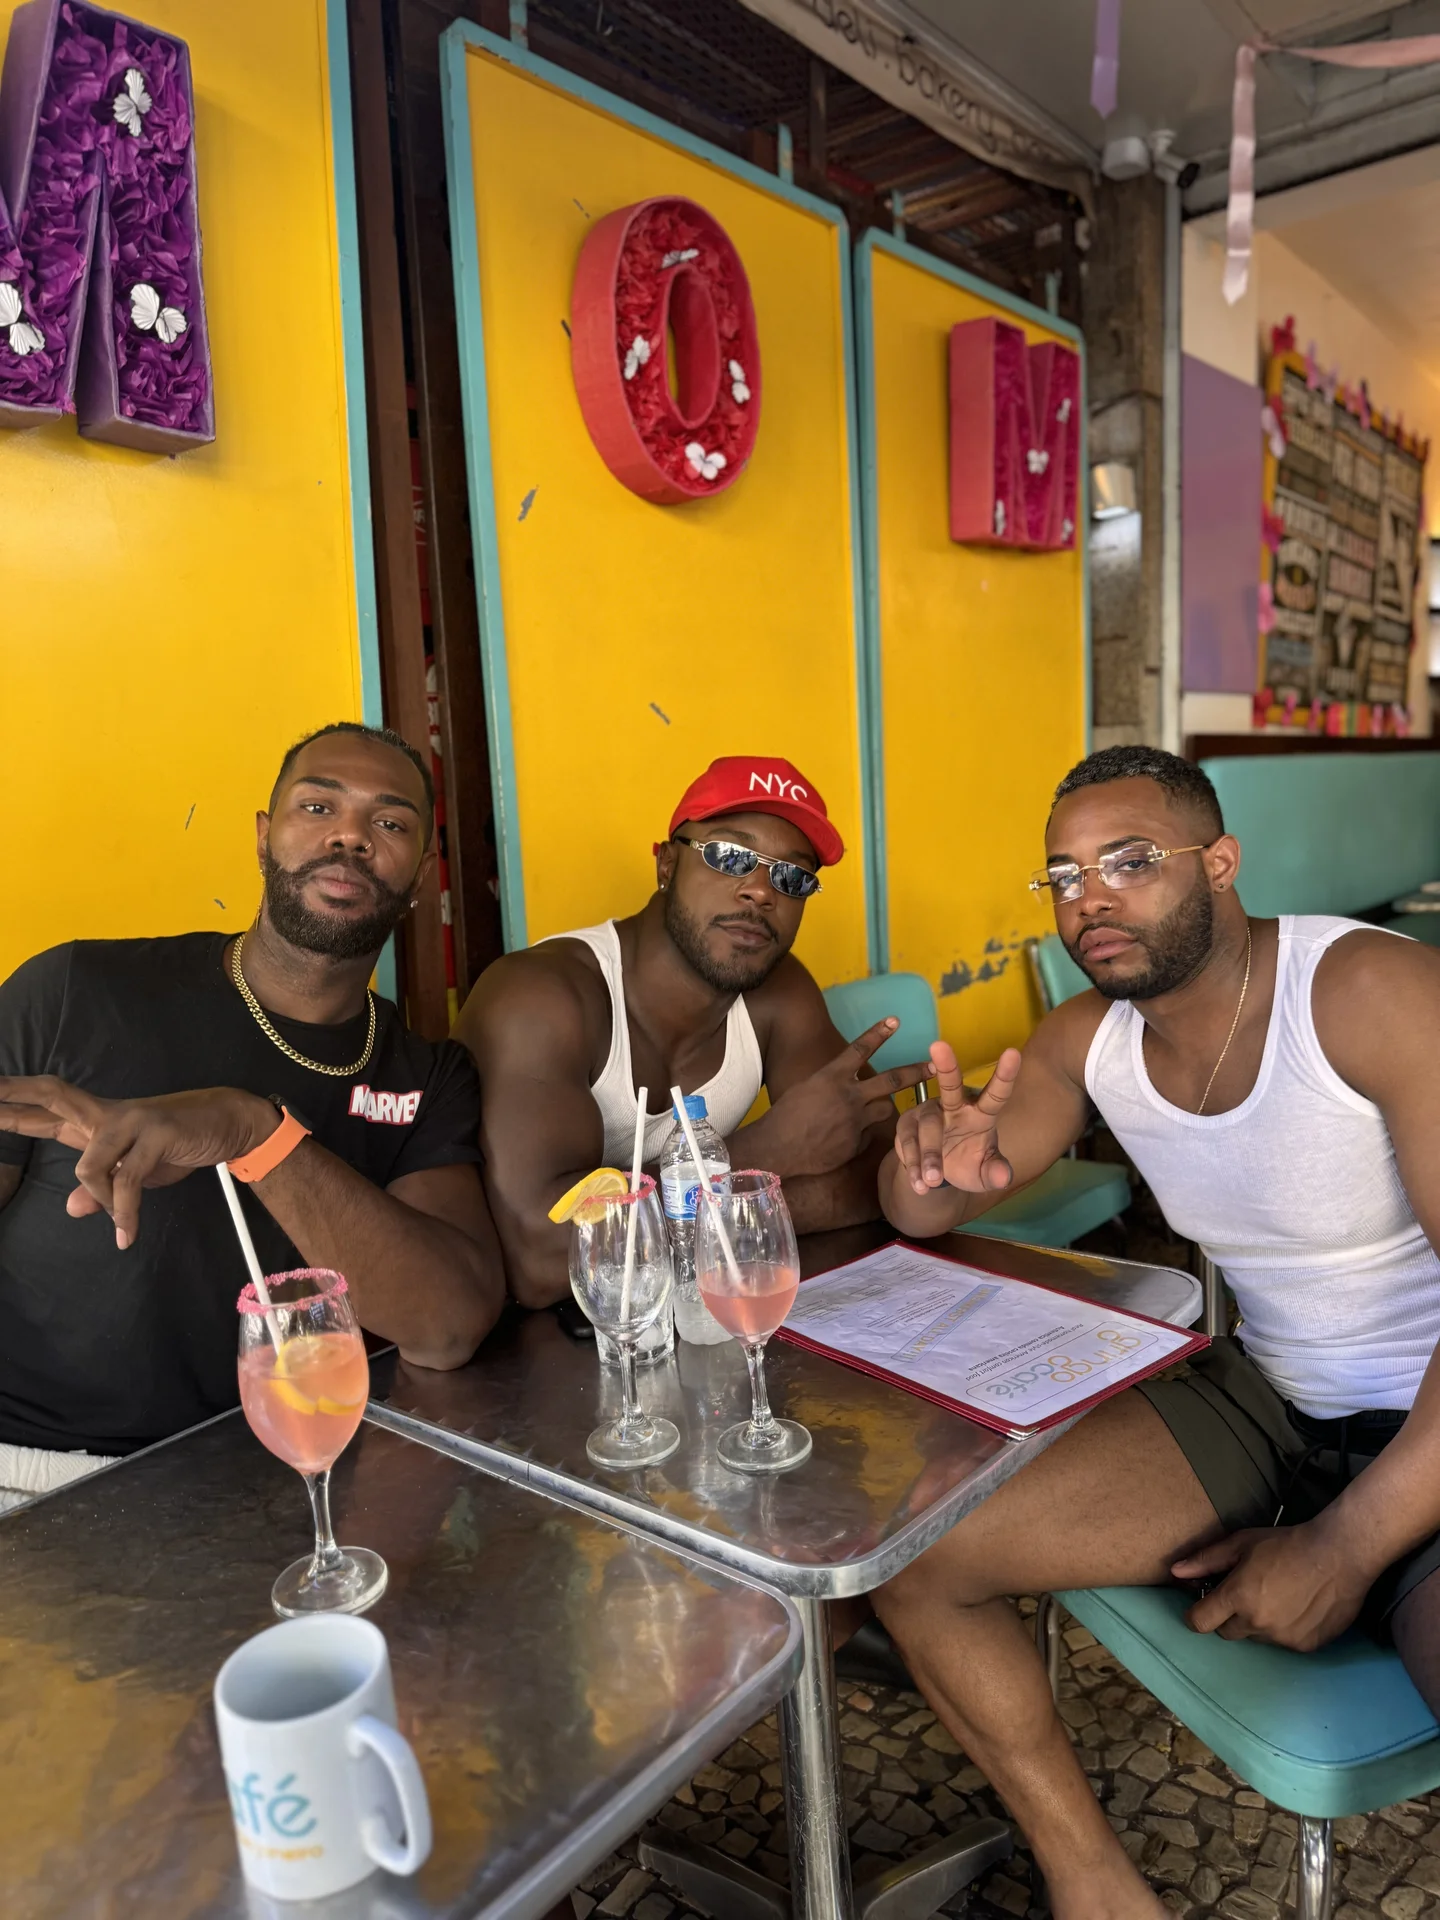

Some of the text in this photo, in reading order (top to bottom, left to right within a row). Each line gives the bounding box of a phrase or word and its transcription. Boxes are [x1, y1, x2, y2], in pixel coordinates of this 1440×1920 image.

[749, 772, 808, 802] NYC
[1047, 1330, 1142, 1383] gringo
[986, 1363, 1055, 1399] café
